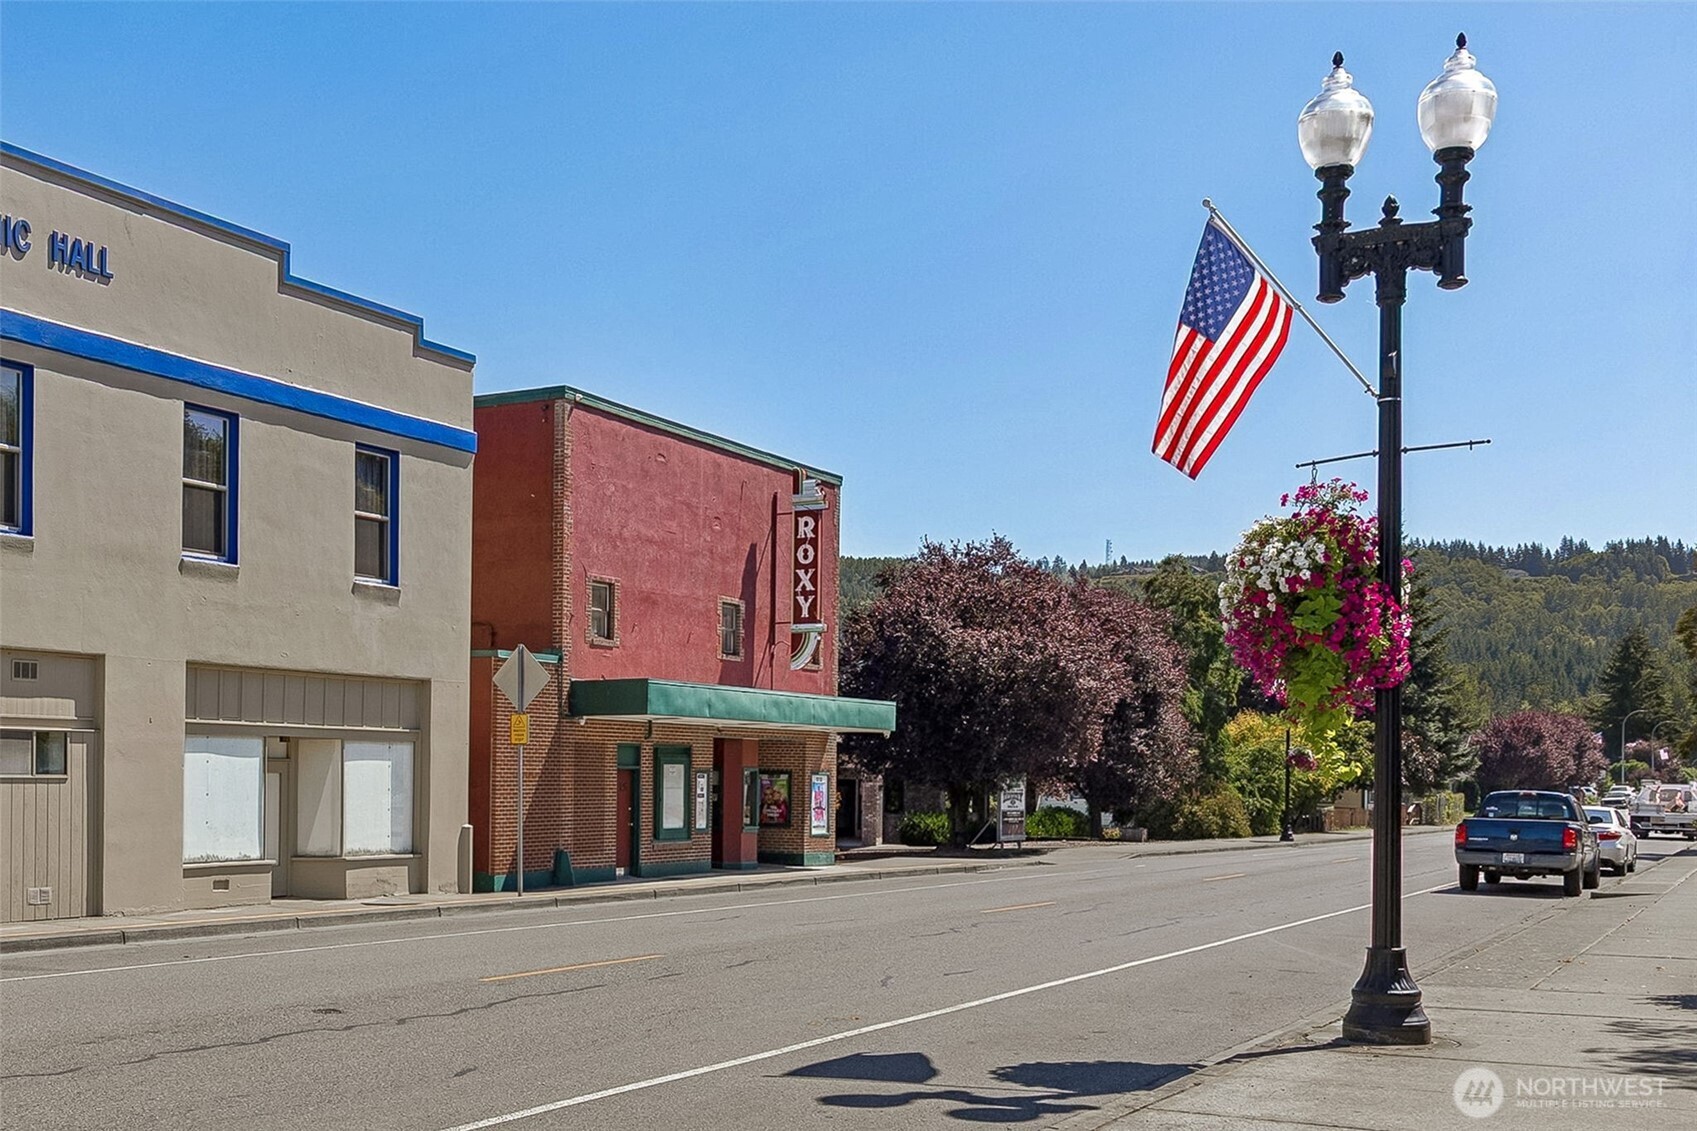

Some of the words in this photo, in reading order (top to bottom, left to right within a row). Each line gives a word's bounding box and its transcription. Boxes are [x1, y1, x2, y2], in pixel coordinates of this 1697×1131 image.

[0, 213, 32, 254] IC
[51, 230, 114, 280] HALL
[795, 516, 815, 617] ROXY
